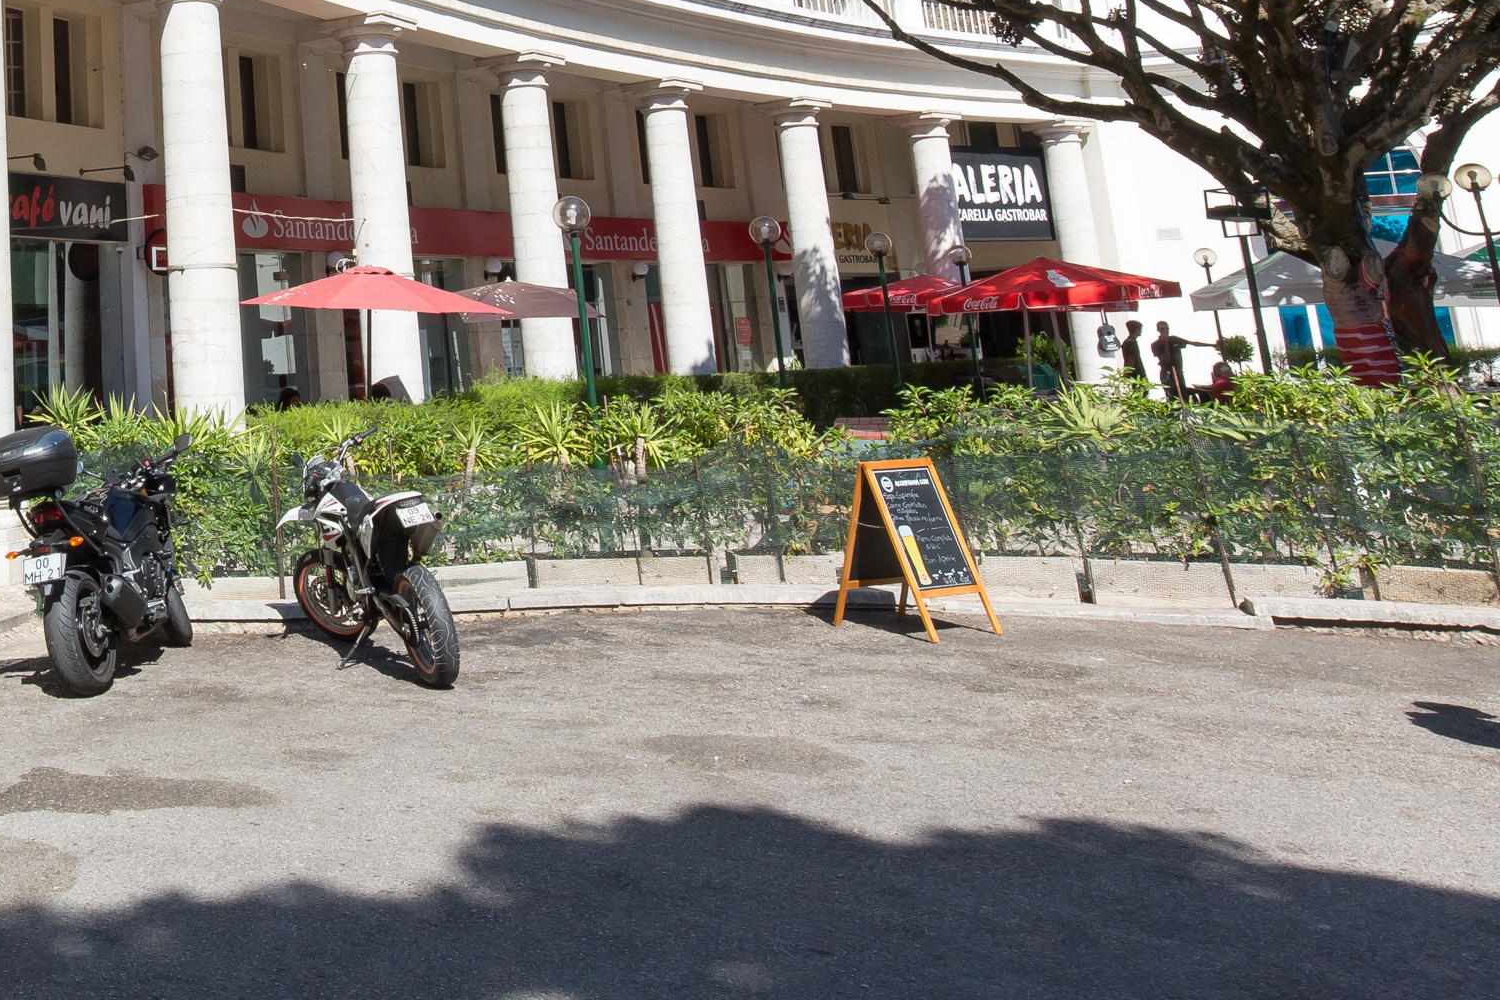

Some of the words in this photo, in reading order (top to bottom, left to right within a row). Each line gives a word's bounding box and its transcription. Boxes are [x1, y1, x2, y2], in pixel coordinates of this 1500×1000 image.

[952, 162, 1043, 206] ALERIA
[9, 184, 55, 228] afé
[995, 208, 1048, 222] GASTROBAR
[273, 209, 355, 241] Santande
[584, 226, 657, 252] Santande
[35, 557, 49, 570] 00
